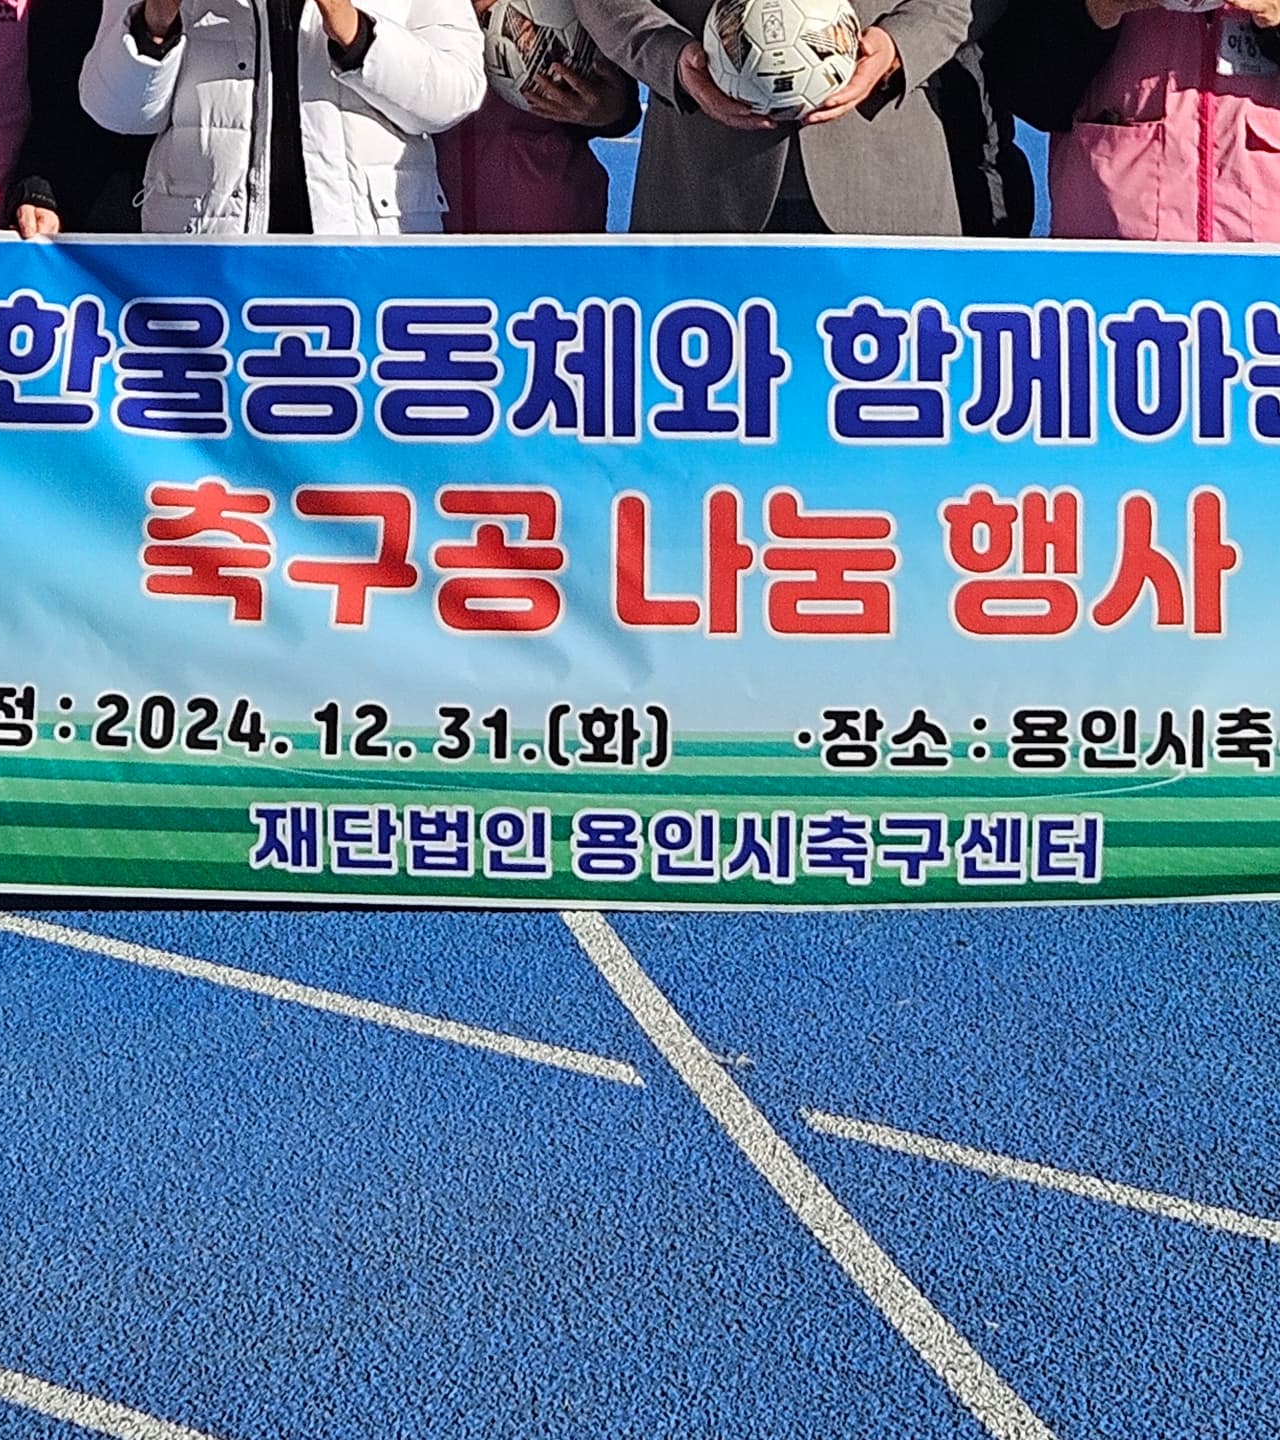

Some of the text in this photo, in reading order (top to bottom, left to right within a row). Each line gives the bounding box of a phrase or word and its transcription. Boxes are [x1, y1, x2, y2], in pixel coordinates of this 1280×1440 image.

[143, 480, 1238, 637] 축구공 나눔 행사
[94, 692, 289, 755] 2024.
[314, 699, 413, 758] 12.
[250, 804, 1102, 882] 재단법인 용인시축구센터
